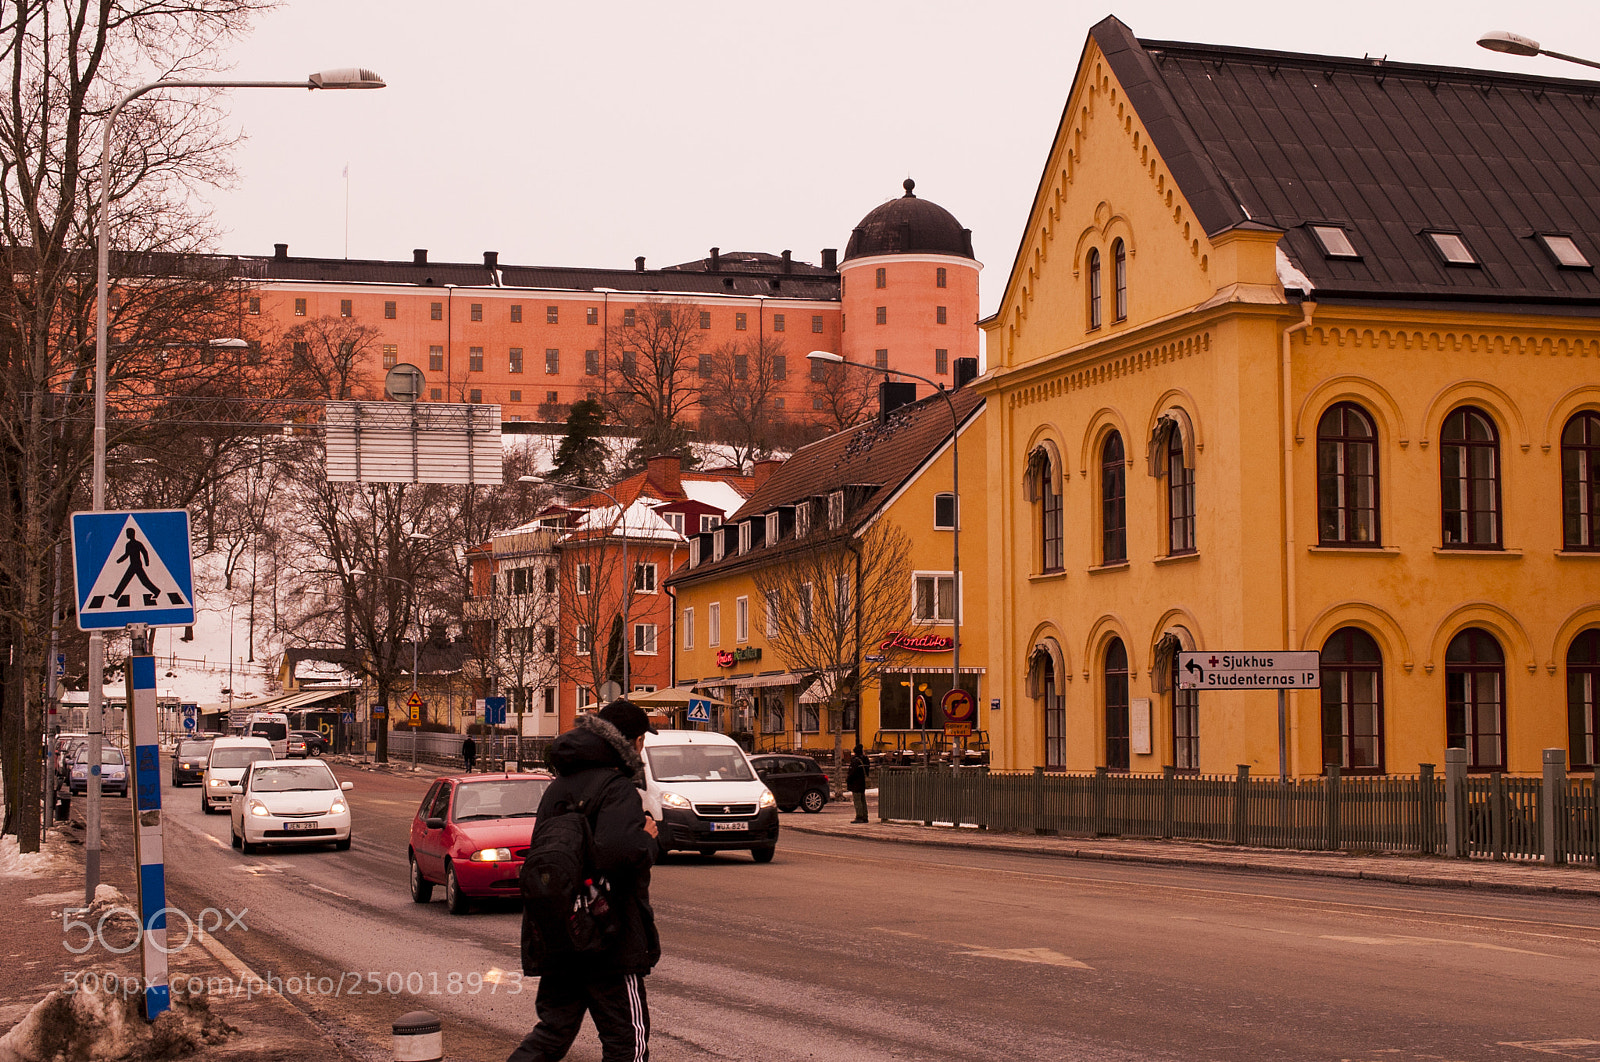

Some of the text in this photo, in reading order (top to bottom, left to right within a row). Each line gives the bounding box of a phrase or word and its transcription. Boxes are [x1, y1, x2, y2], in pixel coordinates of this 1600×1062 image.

[1222, 655, 1274, 670] Sjukhus
[1208, 673, 1315, 685] Studenternas IP
